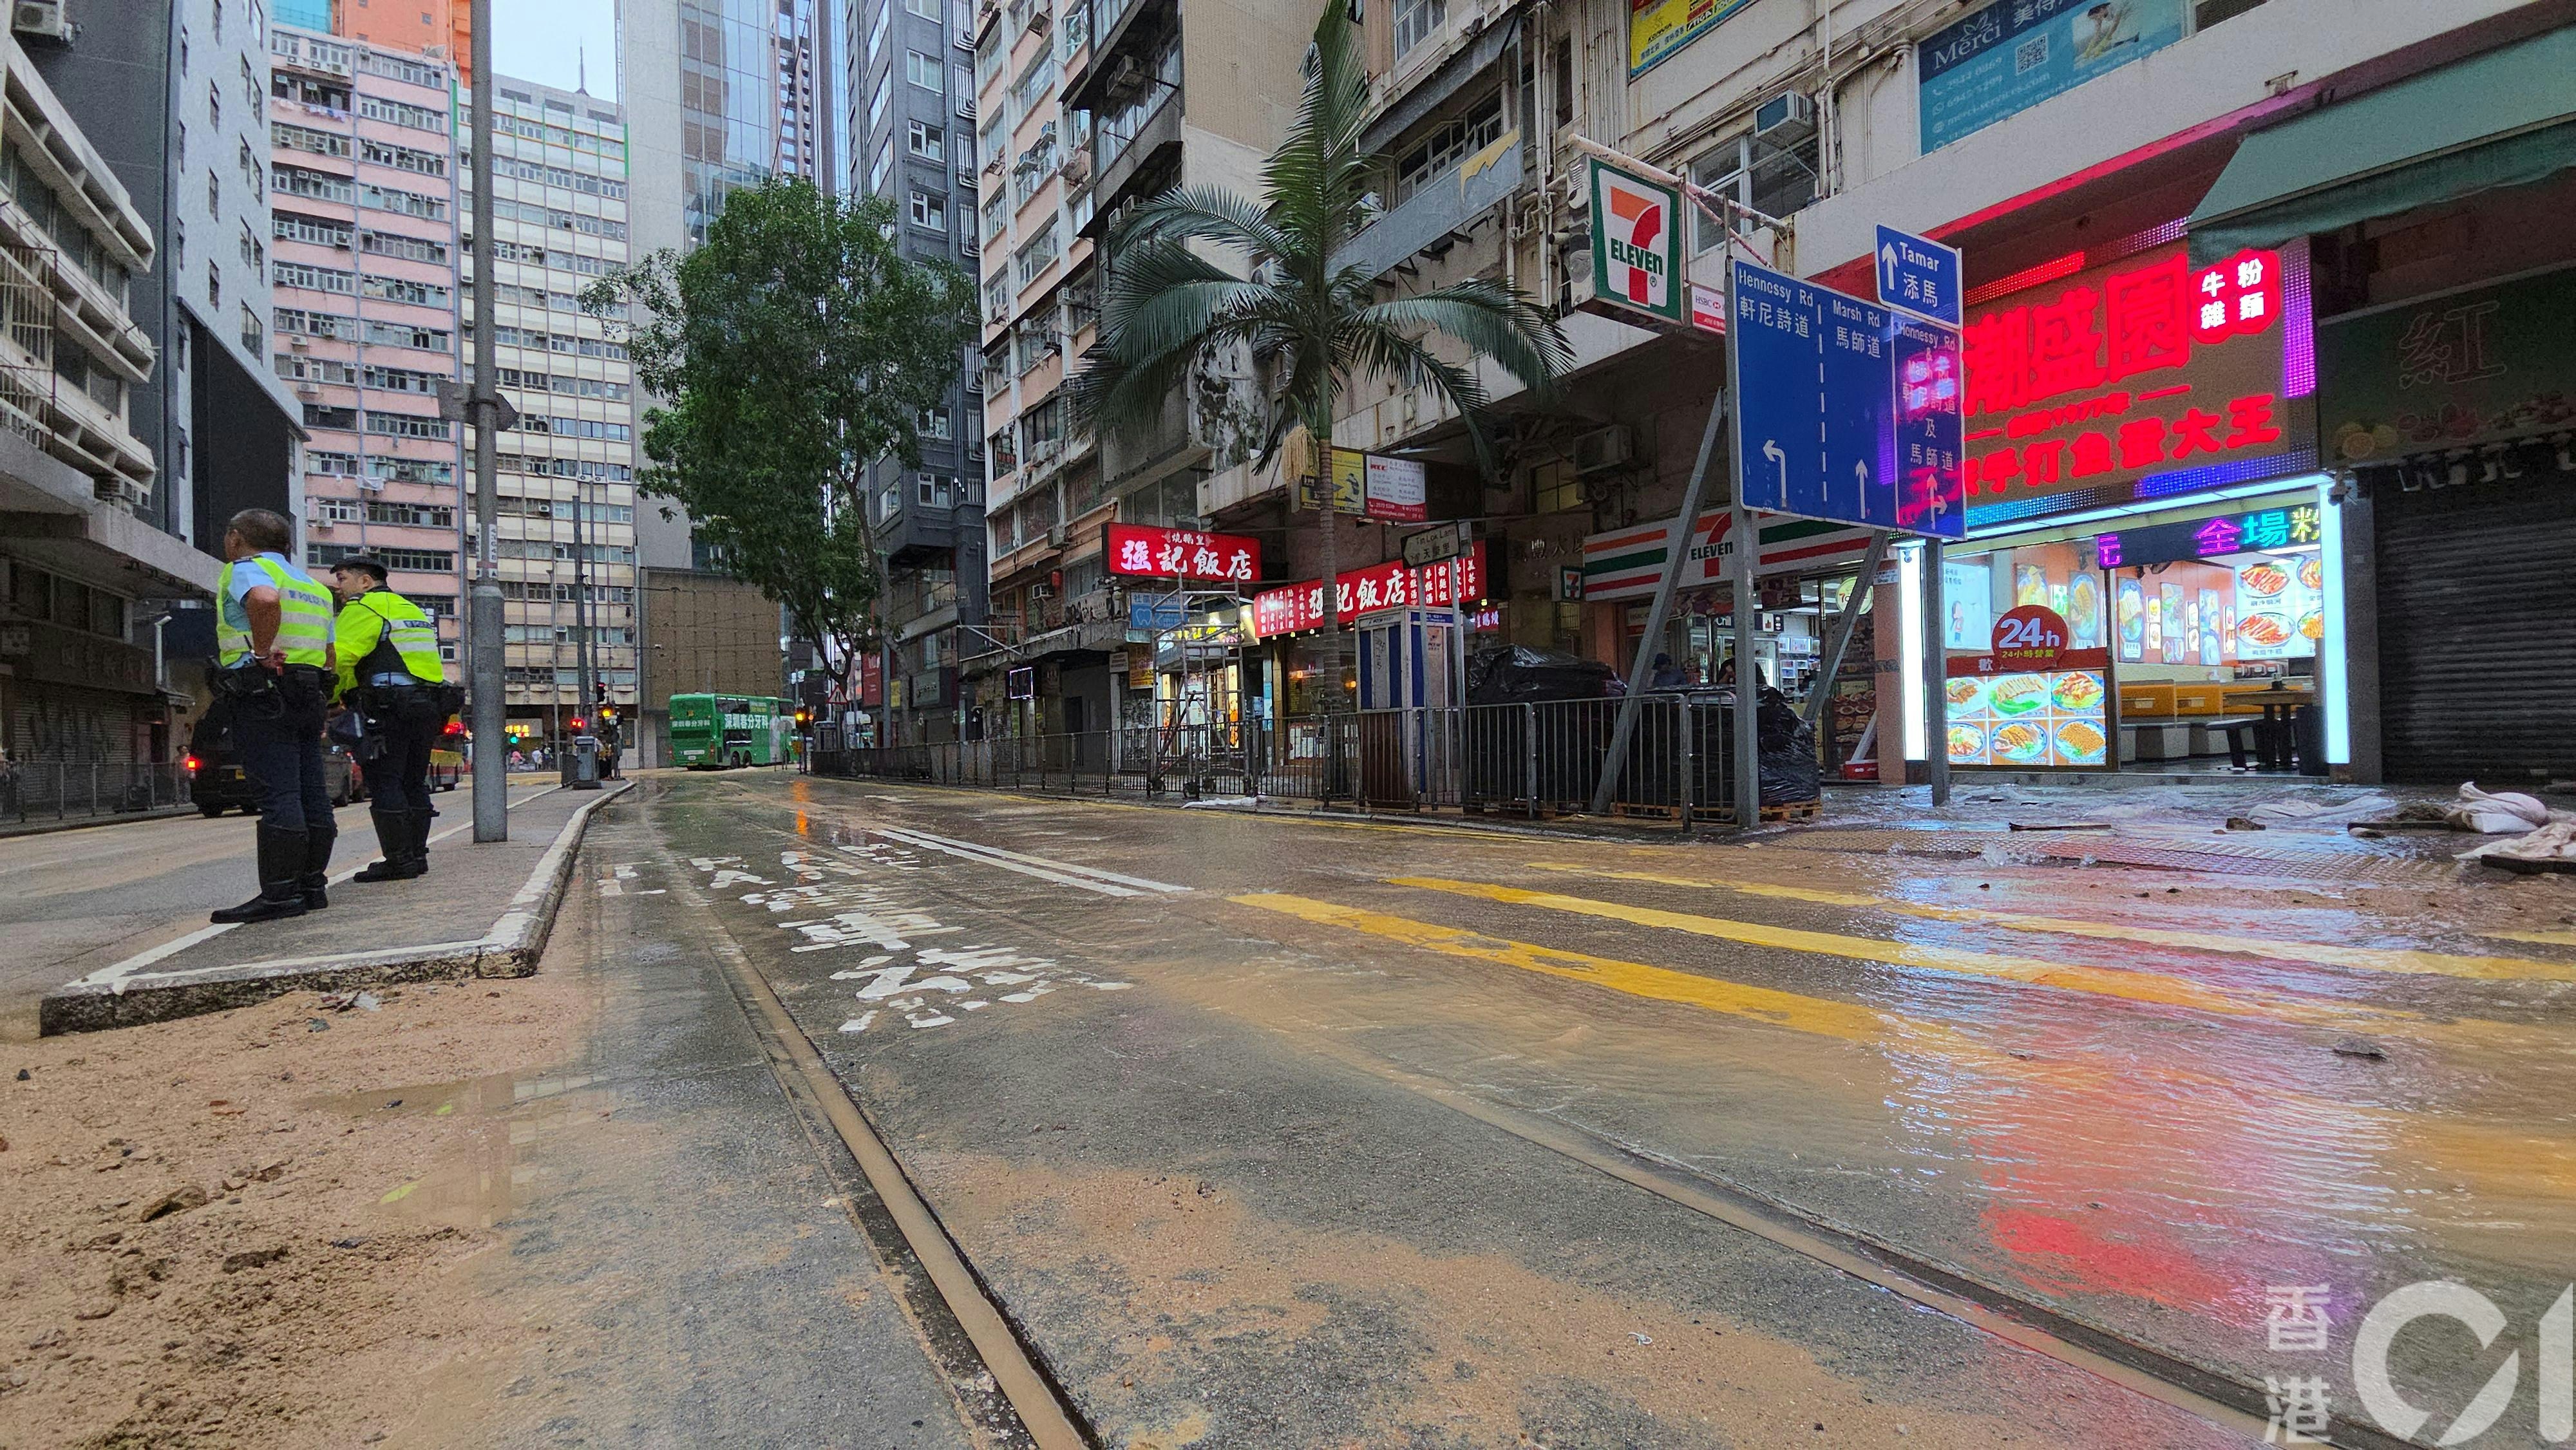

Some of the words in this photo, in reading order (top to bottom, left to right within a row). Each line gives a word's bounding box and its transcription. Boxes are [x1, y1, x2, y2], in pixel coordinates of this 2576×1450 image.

[2014, 0, 2062, 28] 美侍
[1934, 19, 2001, 70] Merci
[1900, 241, 1940, 272] Tamar
[1695, 295, 1712, 308] HSBC
[1739, 269, 1793, 301] Hennessy
[1799, 288, 1814, 308] Rd
[1902, 271, 1938, 308] 添馬
[1740, 295, 1810, 339] 軒尼詩道
[1833, 299, 1862, 323] Marsh
[1868, 311, 1880, 329] Rd
[1836, 326, 1881, 358] 馬師道
[1900, 323, 1938, 348] Hennessy
[1944, 335, 1956, 351] Rd
[1926, 347, 1933, 361] &
[1924, 417, 1937, 438] 及
[1910, 442, 1953, 471] 馬師道
[1998, 617, 2061, 649] 24h
